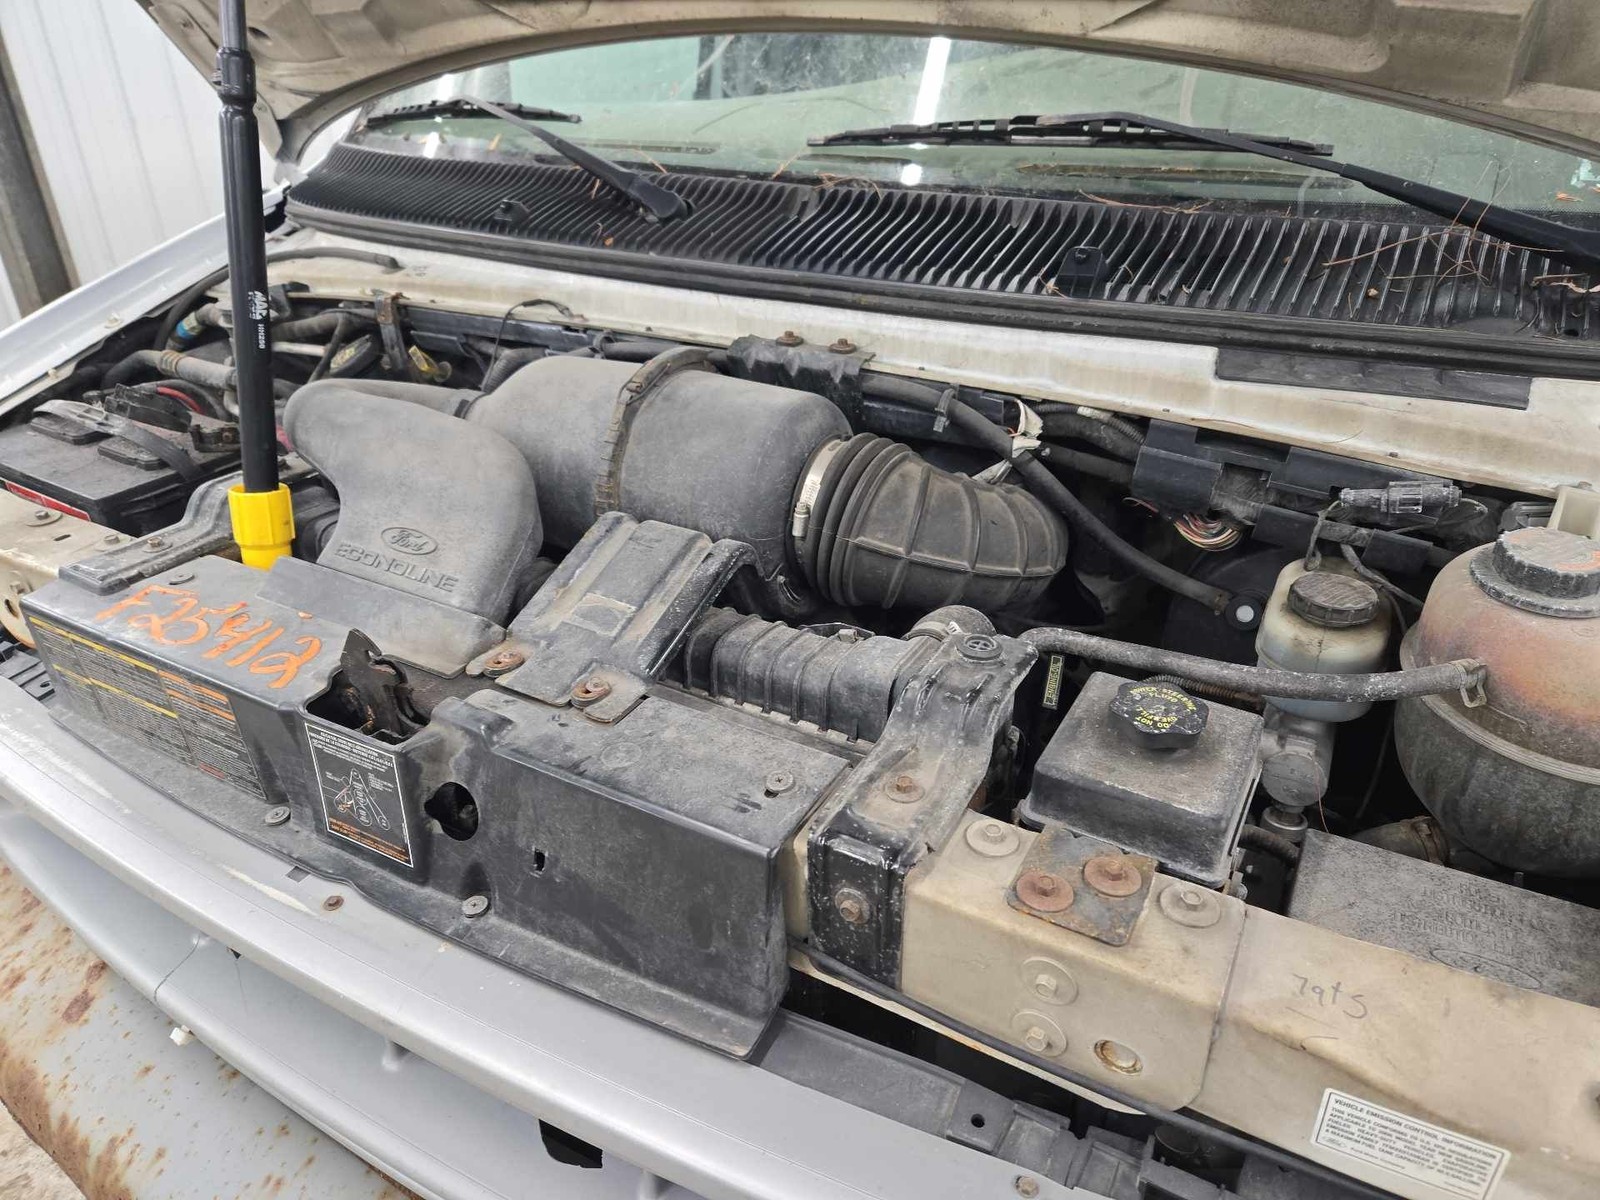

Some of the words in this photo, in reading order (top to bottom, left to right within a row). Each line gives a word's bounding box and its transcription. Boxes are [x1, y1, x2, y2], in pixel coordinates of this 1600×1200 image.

[335, 543, 459, 593] ECONOLINE
[1135, 716, 1153, 726] NOT
[1157, 721, 1170, 729] DO
[1333, 1098, 1364, 1113] VEHICLE
[1365, 1109, 1403, 1126] EMISSION
[1403, 1123, 1438, 1139] CONTROL
[1441, 1137, 1496, 1159] INFORMATION
